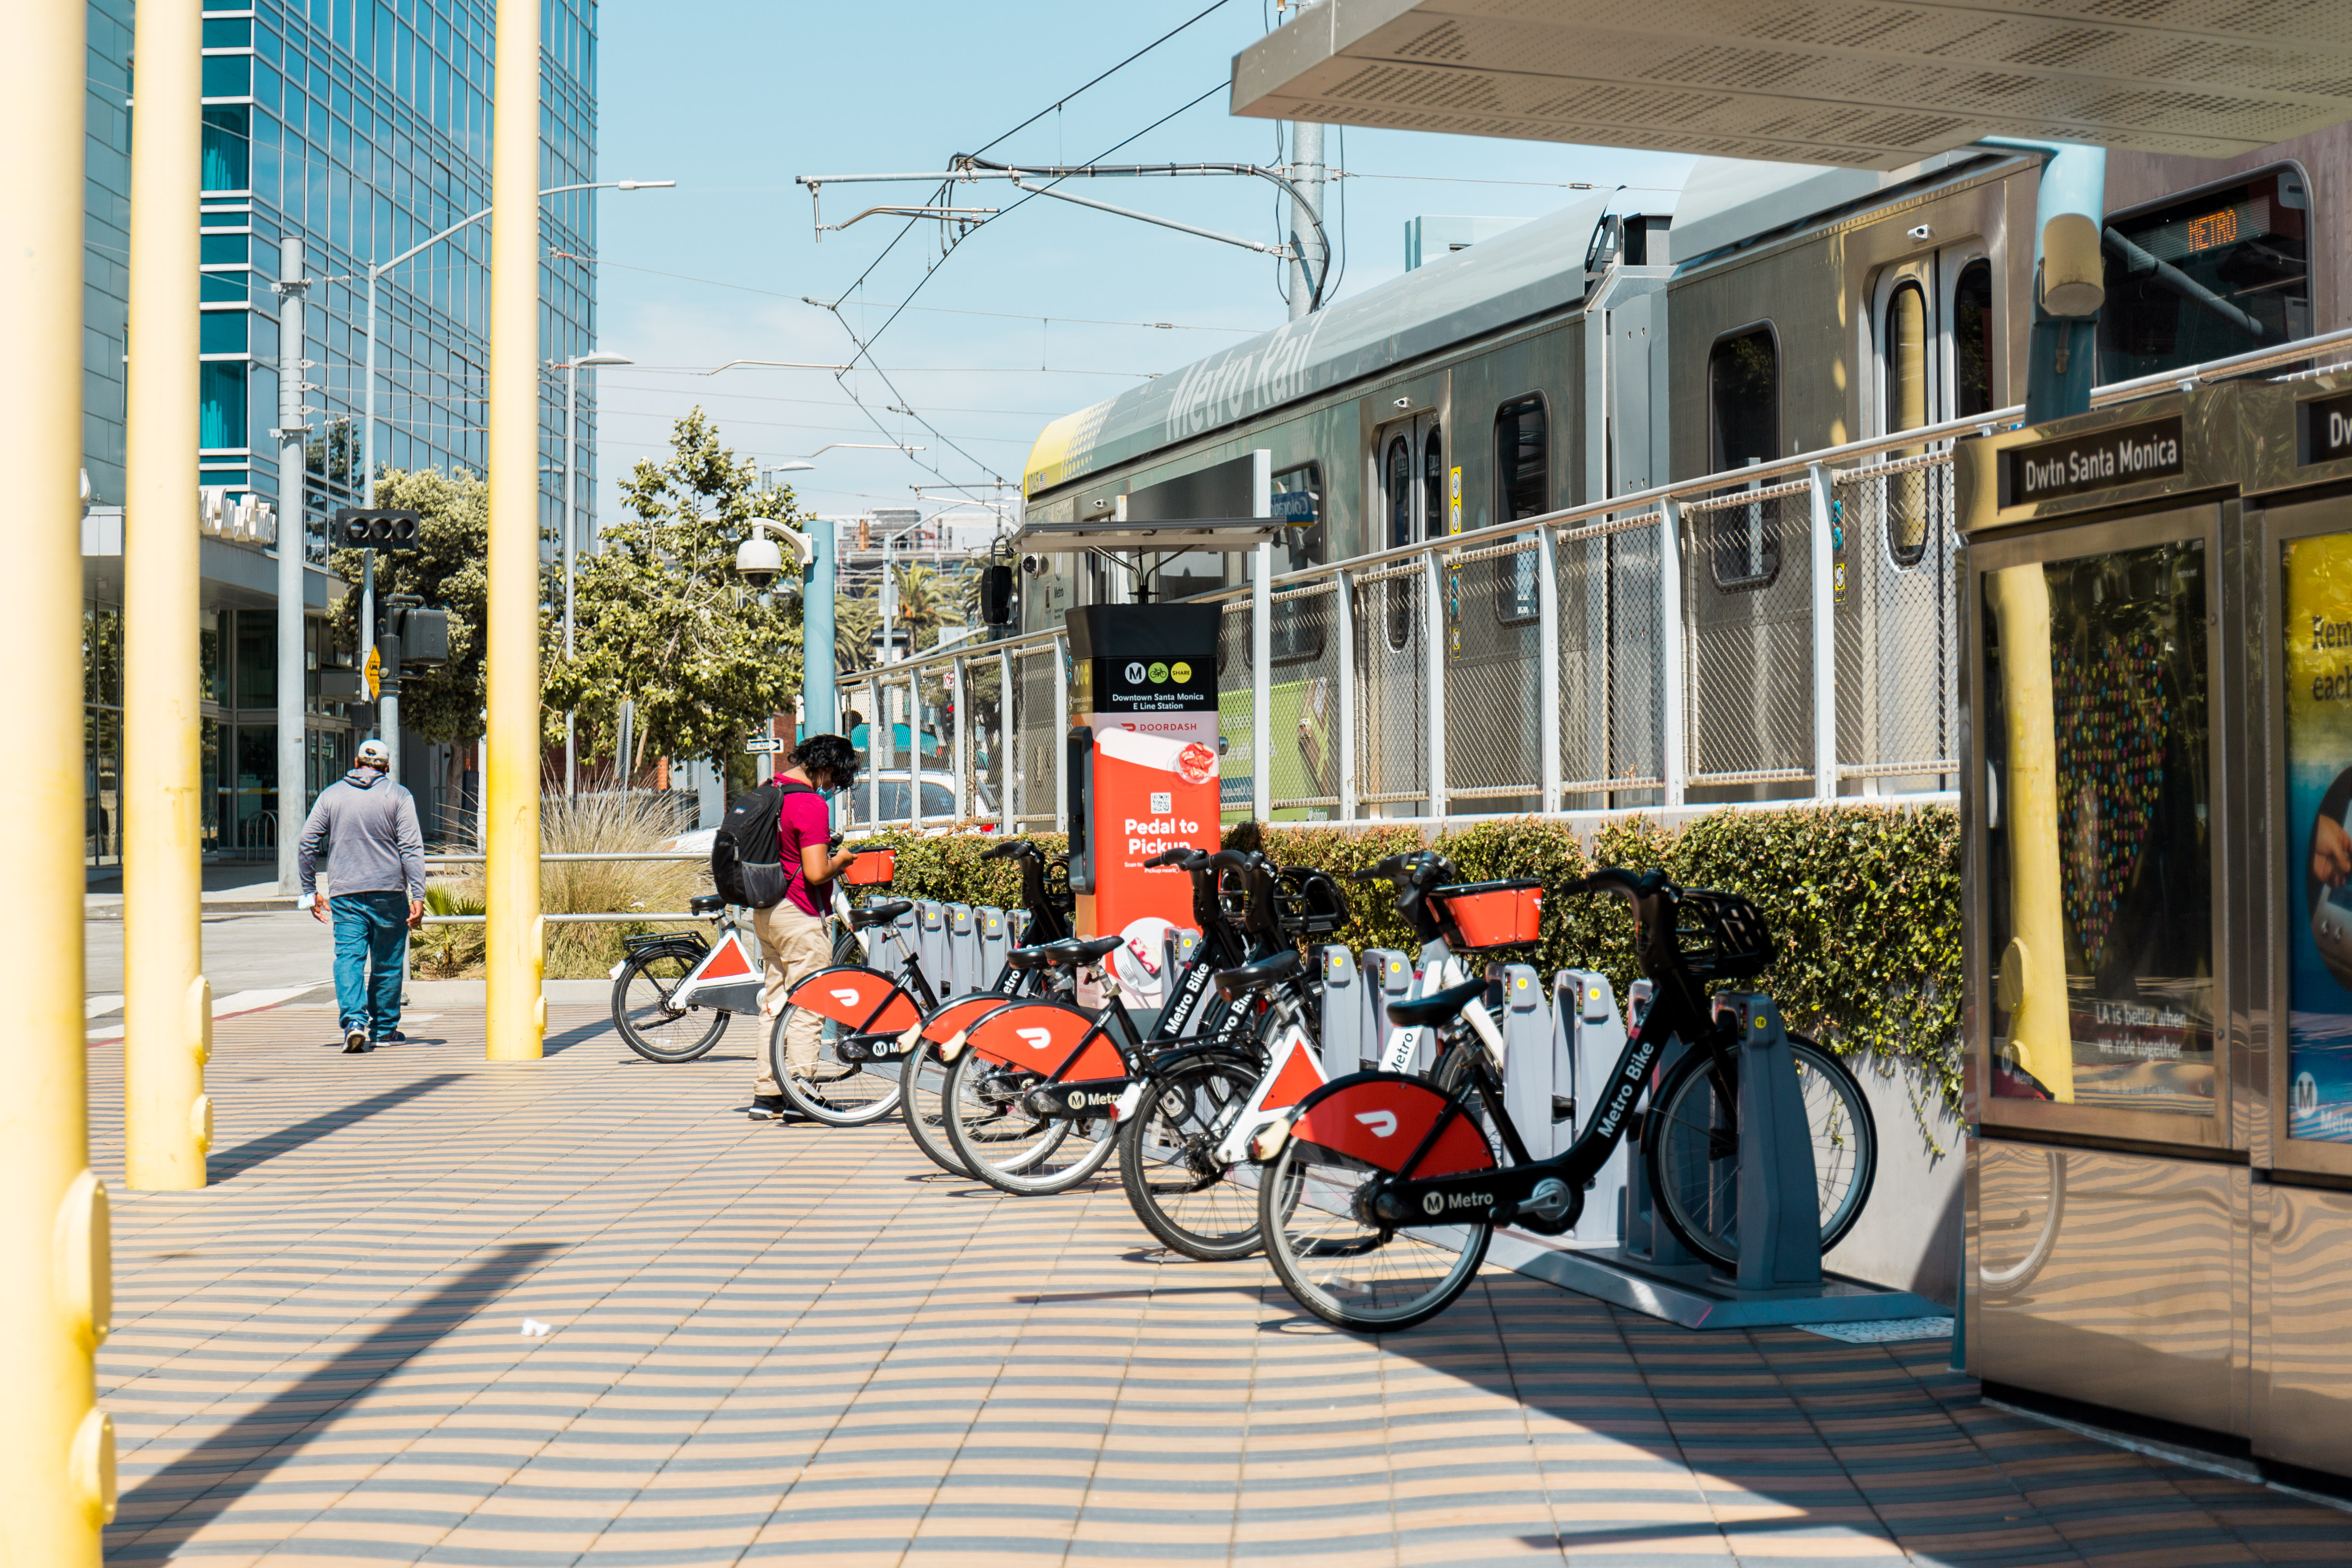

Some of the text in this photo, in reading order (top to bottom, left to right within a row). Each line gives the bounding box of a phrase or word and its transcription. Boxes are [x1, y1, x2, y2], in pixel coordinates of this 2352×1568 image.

[2189, 210, 2236, 252] METRO
[1166, 307, 1331, 442] Metro Rail
[2026, 434, 2177, 492] Dwtn Santa Monica
[1027, 472, 1039, 494] 1045
[1054, 586, 1064, 598] Metro
[1129, 667, 1142, 680] M
[1140, 723, 1197, 731] DOORDASH
[1125, 818, 1199, 835] Pedal to
[1001, 970, 1021, 994] etro
[1164, 963, 1210, 1034] Metro Bike
[2096, 1003, 2187, 1028] LA is better when
[2098, 1032, 2183, 1063] we ride together.
[1598, 1041, 1654, 1138] Metro Bike
[2014, 1071, 2034, 1086] Metro
[1072, 1095, 1082, 1106] M
[2298, 1080, 2313, 1110] M
[1427, 1192, 1494, 1211] M Metro
